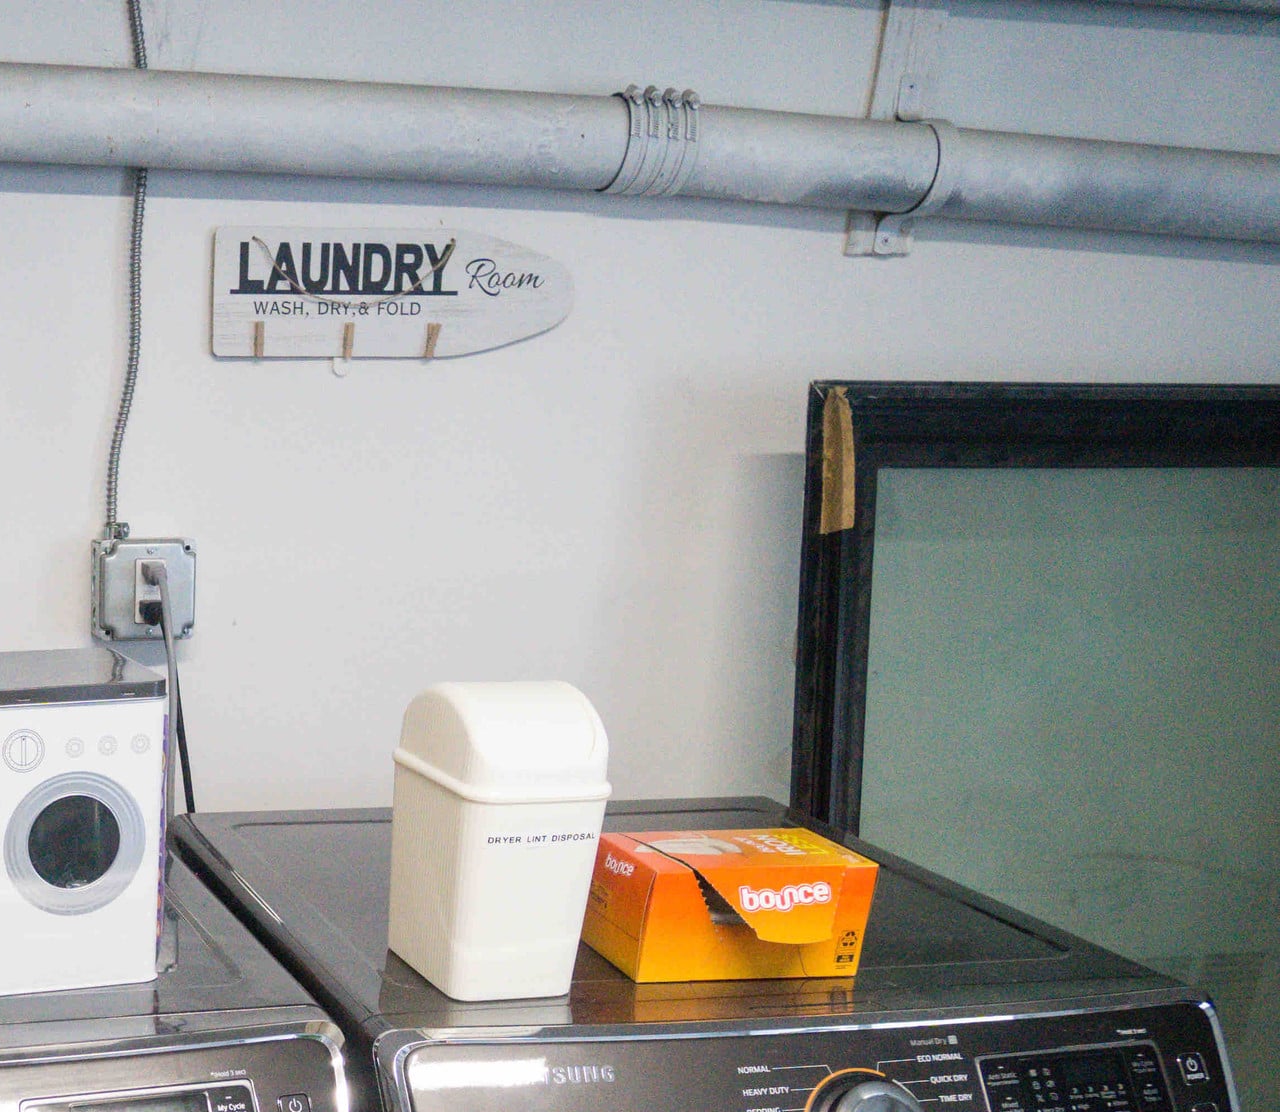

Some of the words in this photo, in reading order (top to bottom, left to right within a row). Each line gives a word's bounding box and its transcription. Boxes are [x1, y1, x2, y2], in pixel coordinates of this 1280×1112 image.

[235, 241, 456, 294] LAUNDRY
[465, 258, 545, 297] Room
[254, 300, 310, 316] WASH,
[377, 301, 421, 316] FOLD
[487, 834, 522, 844] DRYER
[526, 834, 547, 843] LINT
[551, 832, 595, 842] DISPOSAL
[604, 853, 635, 876] bounce
[740, 881, 831, 912] bounce
[932, 1053, 963, 1061] NORMAL
[737, 1065, 770, 1074] NORMAL
[930, 1076, 952, 1084] QUICK
[953, 1074, 968, 1083] DRY
[742, 1088, 768, 1097] HEAVY
[770, 1086, 789, 1095] DUTY
[957, 1094, 972, 1102] DRY
[218, 1104, 228, 1112] My
[229, 1102, 245, 1111] Cycle
